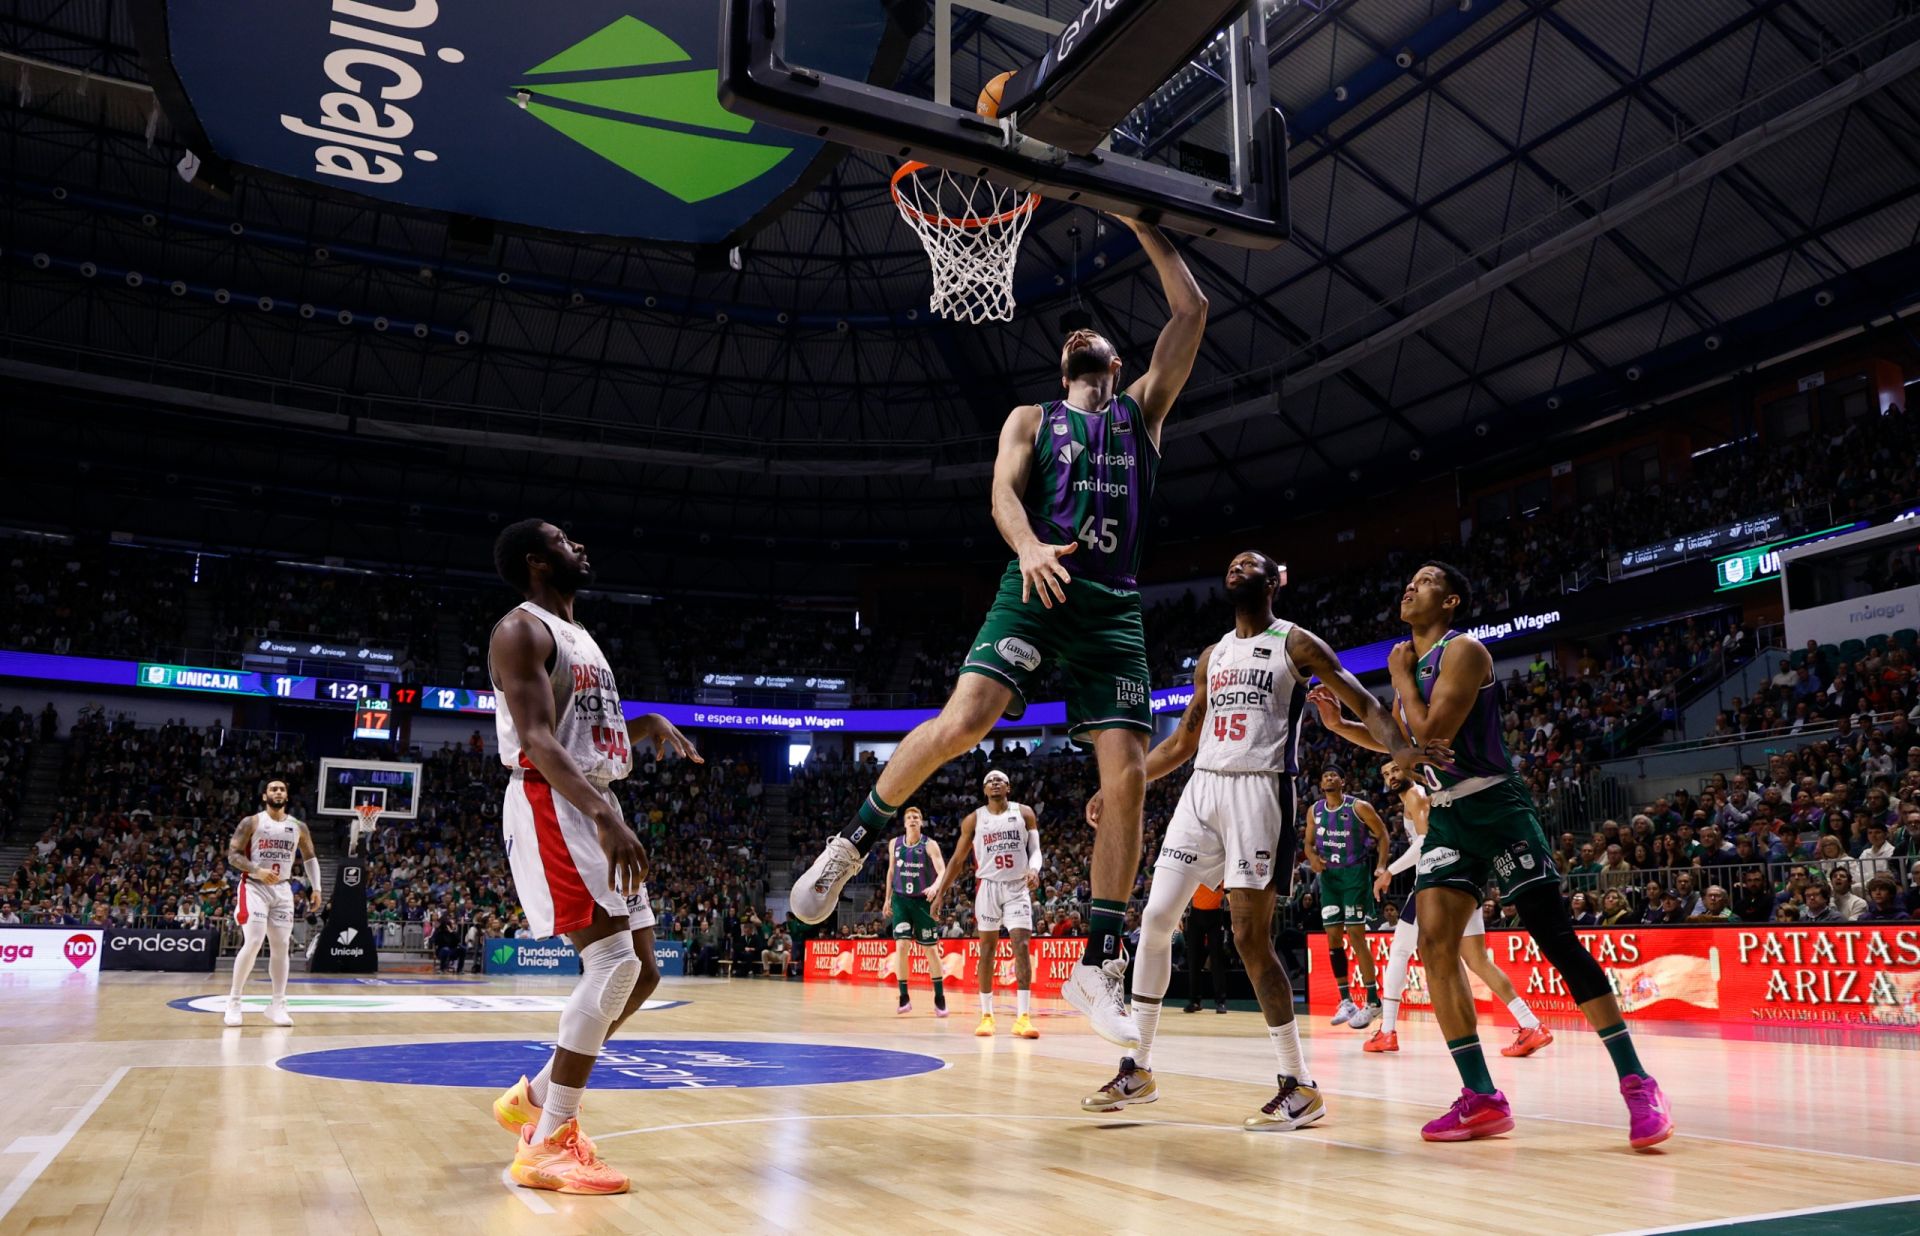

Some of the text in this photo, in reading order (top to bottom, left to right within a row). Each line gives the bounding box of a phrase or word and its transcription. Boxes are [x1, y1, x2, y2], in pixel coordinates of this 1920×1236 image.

[1057, 0, 1119, 61] en
[1088, 452, 1135, 469] Unicaja
[1073, 476, 1128, 497] málaga
[1078, 515, 1118, 553] 45
[1850, 603, 1905, 623] málaga
[1468, 611, 1560, 640] Málaga Wagen
[176, 671, 239, 690] UNICAJA
[276, 677, 291, 697] 11
[328, 682, 368, 700] 1:21
[396, 688, 416, 704] 17
[437, 690, 454, 709] 12
[365, 701, 388, 710] 1:20
[478, 695, 495, 710] BA
[363, 712, 387, 730] 17
[694, 712, 844, 729] te espera en Málaga Wagen
[1214, 713, 1247, 742] 45
[591, 725, 628, 764] 44
[1326, 829, 1350, 837] Unicaja
[1322, 840, 1346, 848] málaga
[994, 854, 1014, 869] 95
[905, 882, 914, 894] 9
[66, 941, 95, 956] 101
[110, 933, 206, 952] endesa
[812, 941, 840, 955] PATATAS
[856, 941, 888, 956] PATATAS
[1042, 941, 1086, 958] PATATA
[1738, 930, 1920, 965] PATATAS
[330, 947, 364, 957] Unicaja
[517, 946, 575, 957] Fundación
[517, 957, 559, 967] Unicaja
[1765, 969, 1900, 1005] ARIZA
